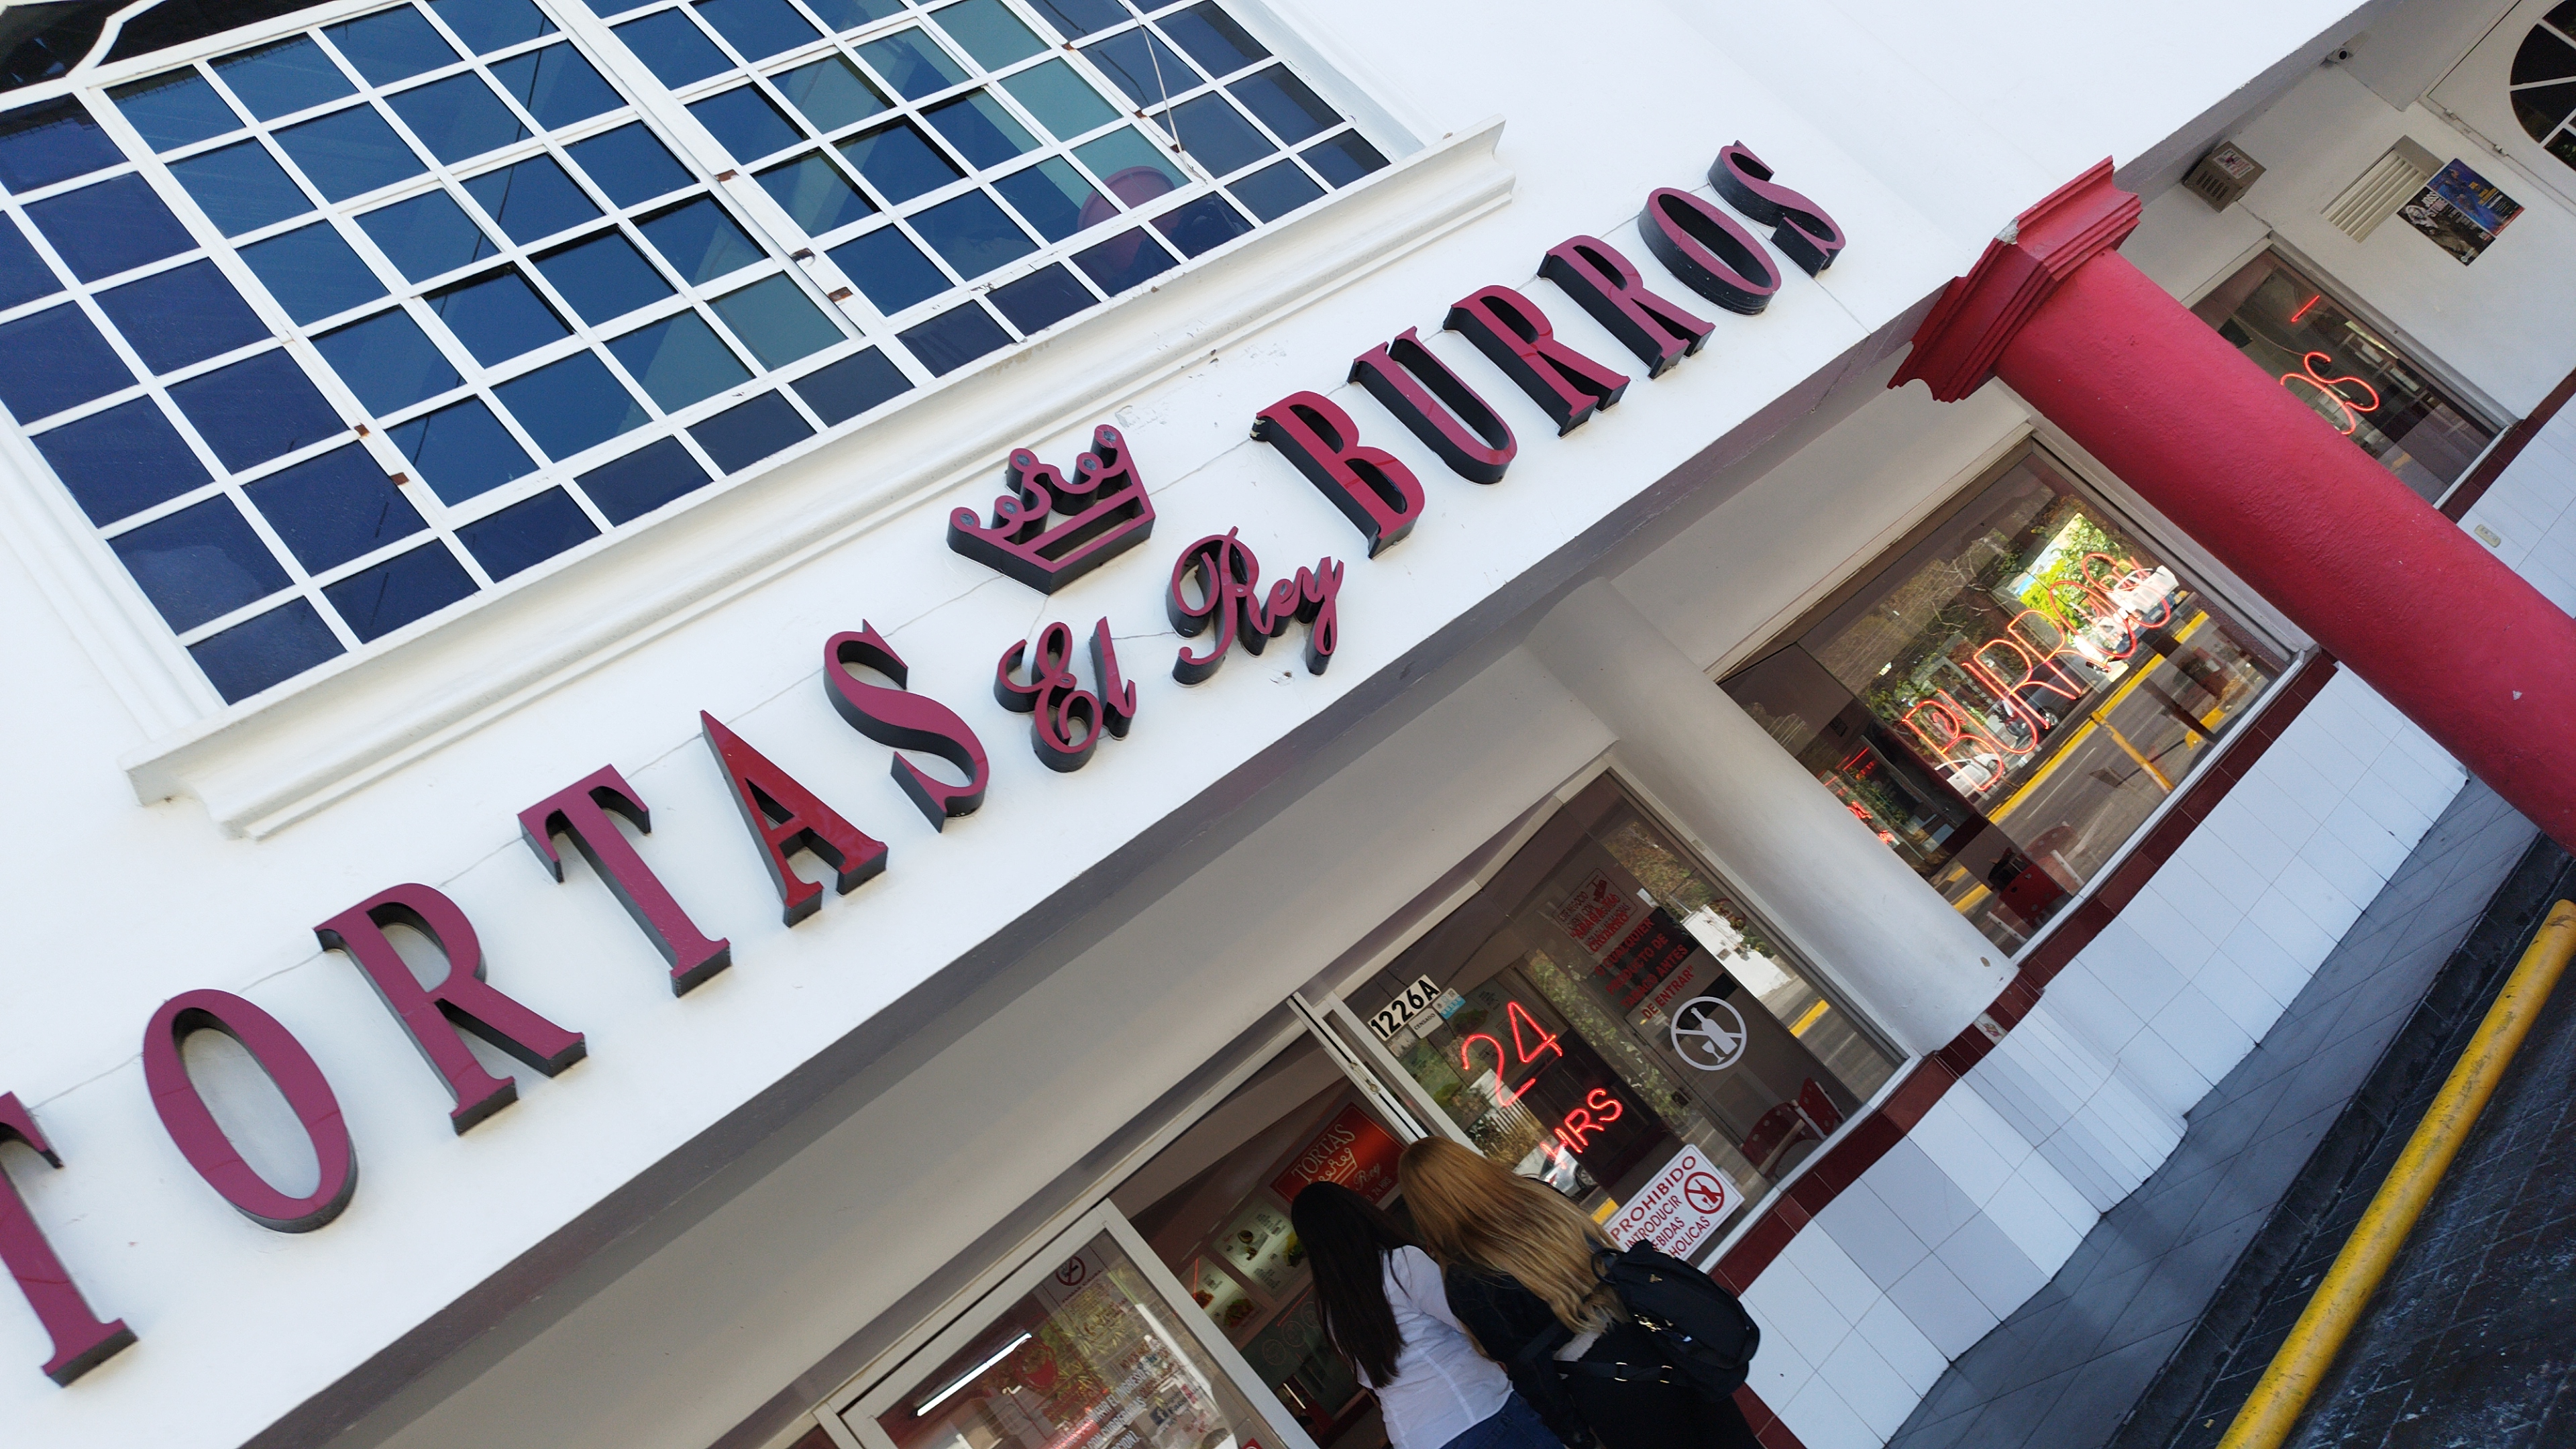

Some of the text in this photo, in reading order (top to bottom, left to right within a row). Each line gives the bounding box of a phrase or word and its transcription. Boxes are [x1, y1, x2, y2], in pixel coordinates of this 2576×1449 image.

[1250, 140, 1846, 559] BURROS
[994, 526, 1344, 773] El Rey
[1901, 552, 2171, 792] BURROS
[1566, 891, 1589, 914] NEGOCIO
[1589, 912, 1629, 953] CIGARRO
[1595, 965, 1605, 976] O
[1602, 917, 1655, 968] CUALQUIER
[1605, 933, 1668, 996] PRODUCTO DE
[1620, 944, 1688, 1008] TABACO ANTES
[0, 618, 989, 1387] TORTAS
[1371, 979, 1440, 1038] 1226A
[1413, 1013, 1436, 1031] CENSADO
[1641, 965, 1695, 1020] DE ENTRAR"
[1461, 1001, 1563, 1108] 24
[1291, 1124, 1356, 1185] TORTAS
[1540, 1087, 1623, 1170] HRS
[1610, 1156, 1696, 1241] PROHIBIDO
[1624, 1195, 1682, 1250] INTRODUCIR
[1652, 1216, 1685, 1250] EBIDAS
[1668, 1216, 1711, 1256] HOLICAS
[1106, 1393, 1120, 1407] EL
